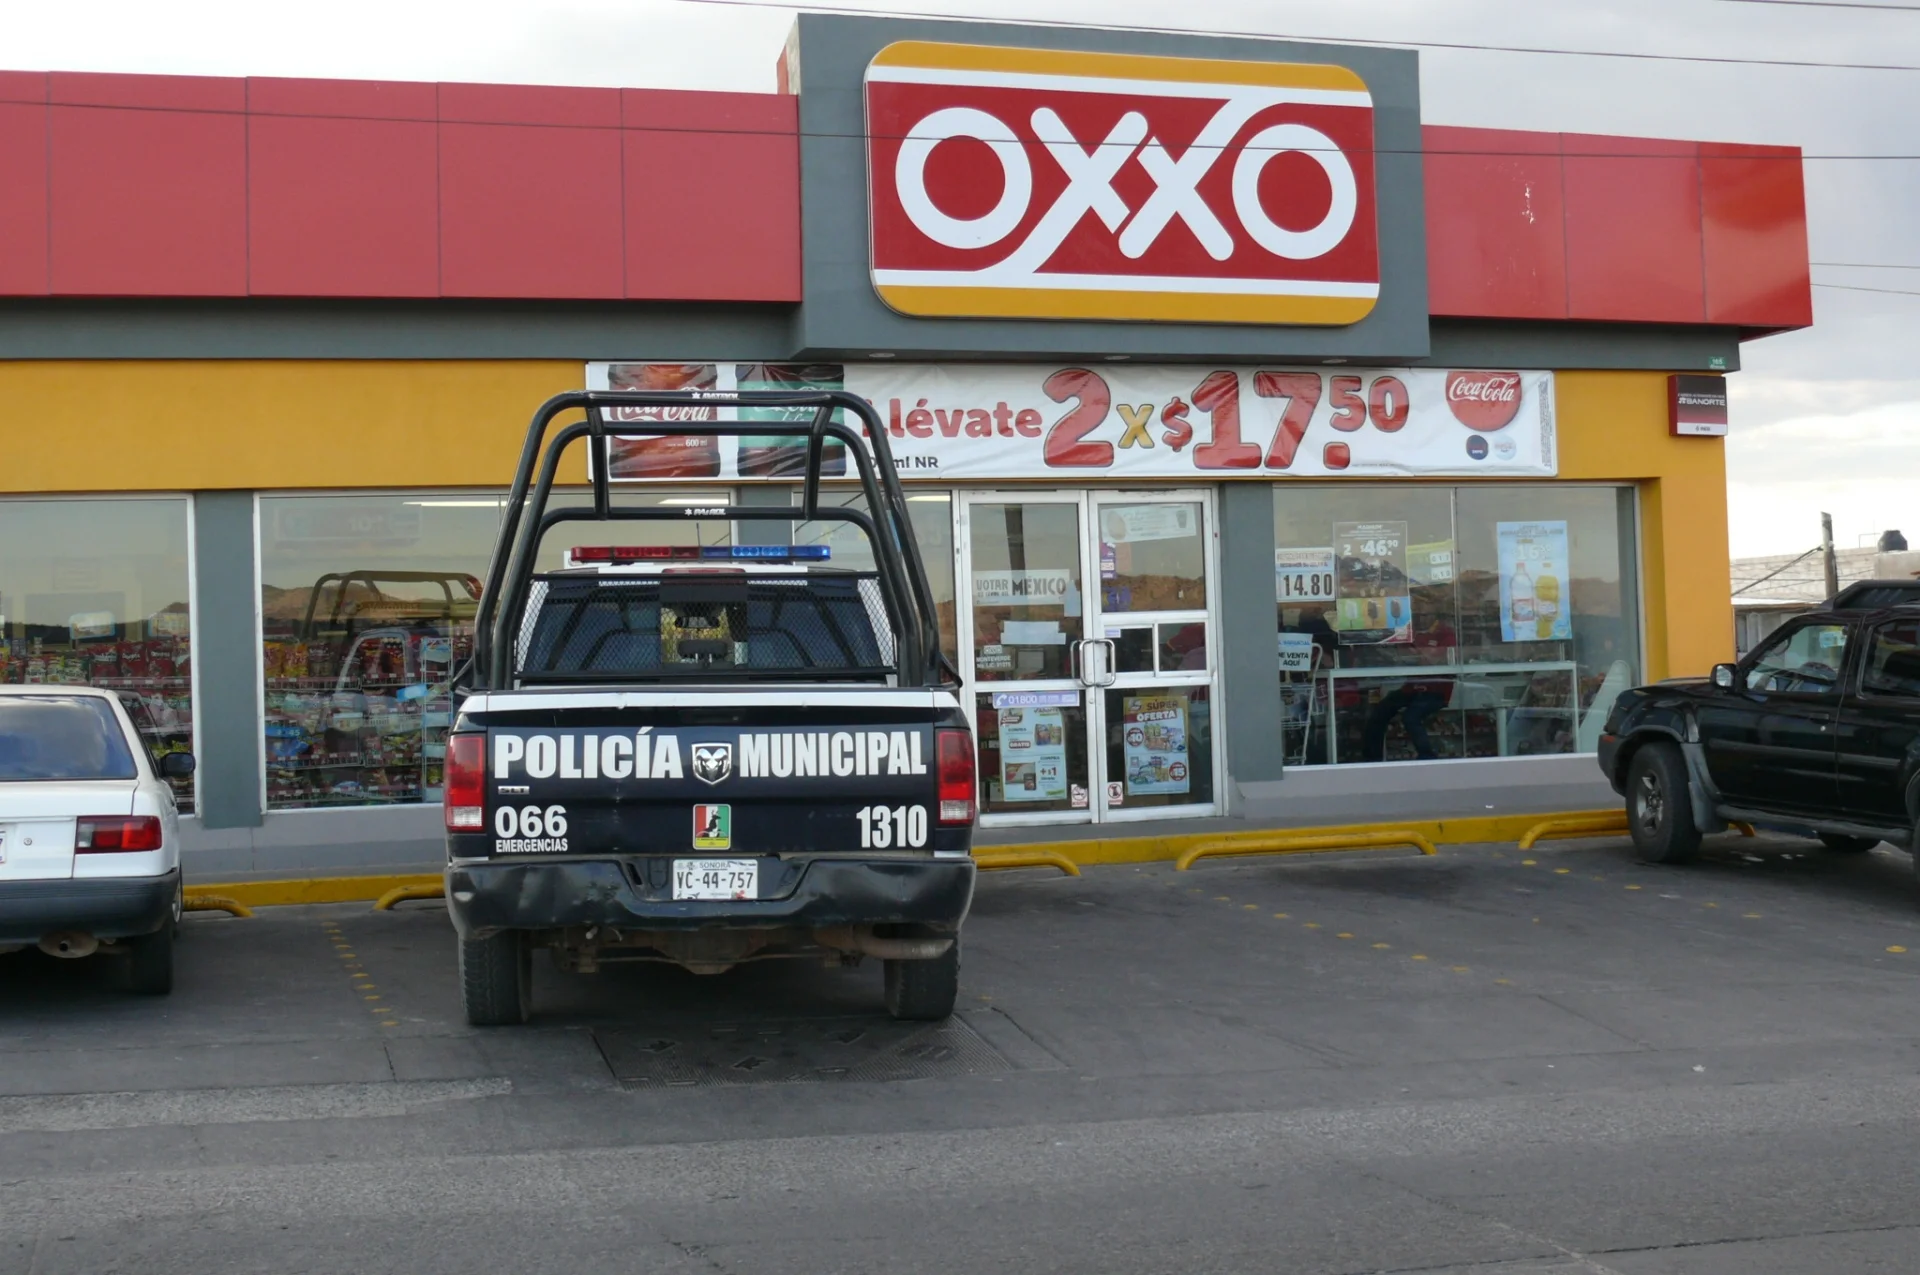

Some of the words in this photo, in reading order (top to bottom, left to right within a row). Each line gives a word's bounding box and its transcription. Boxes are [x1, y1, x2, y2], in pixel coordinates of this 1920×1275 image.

[894, 100, 1357, 274] OXXO
[1448, 376, 1519, 402] Coca-Cola
[1687, 398, 1726, 406] BANORTE
[862, 398, 1042, 438] lévate
[1042, 367, 1114, 468] 2
[915, 457, 939, 468] NR
[976, 579, 1009, 591] VOTAR
[1283, 573, 1333, 597] 14.80
[1136, 710, 1176, 721] OFERTA
[494, 727, 684, 779] POLICÍA
[739, 731, 927, 777] MUNICIPAL
[494, 805, 568, 838] 066
[856, 805, 928, 848] 1310
[495, 838, 568, 852] EMERGENCIAS
